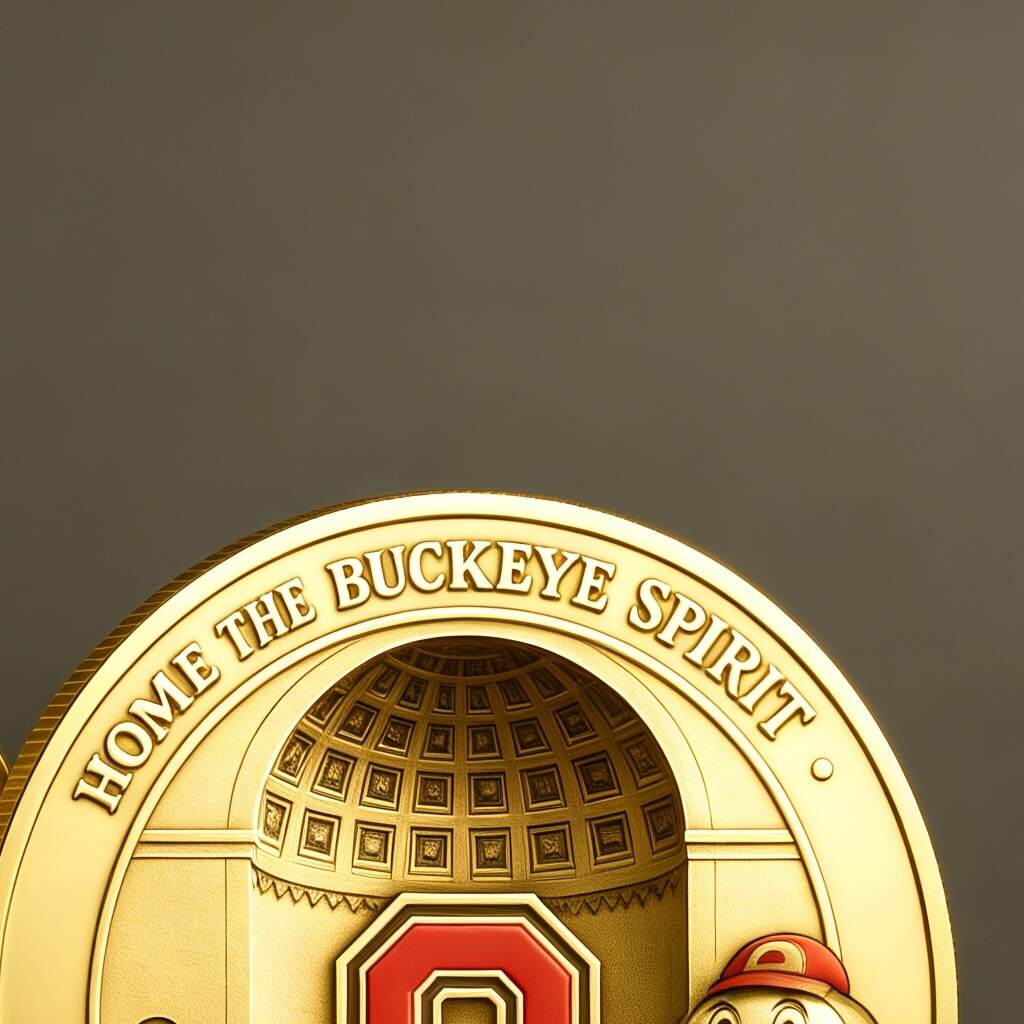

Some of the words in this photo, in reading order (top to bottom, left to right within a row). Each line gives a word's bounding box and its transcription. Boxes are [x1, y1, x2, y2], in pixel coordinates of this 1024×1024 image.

[73, 642, 221, 815] HOME
[215, 577, 318, 662] THE
[326, 539, 617, 613] BUCKEYE
[628, 577, 817, 742] SPIRIT
